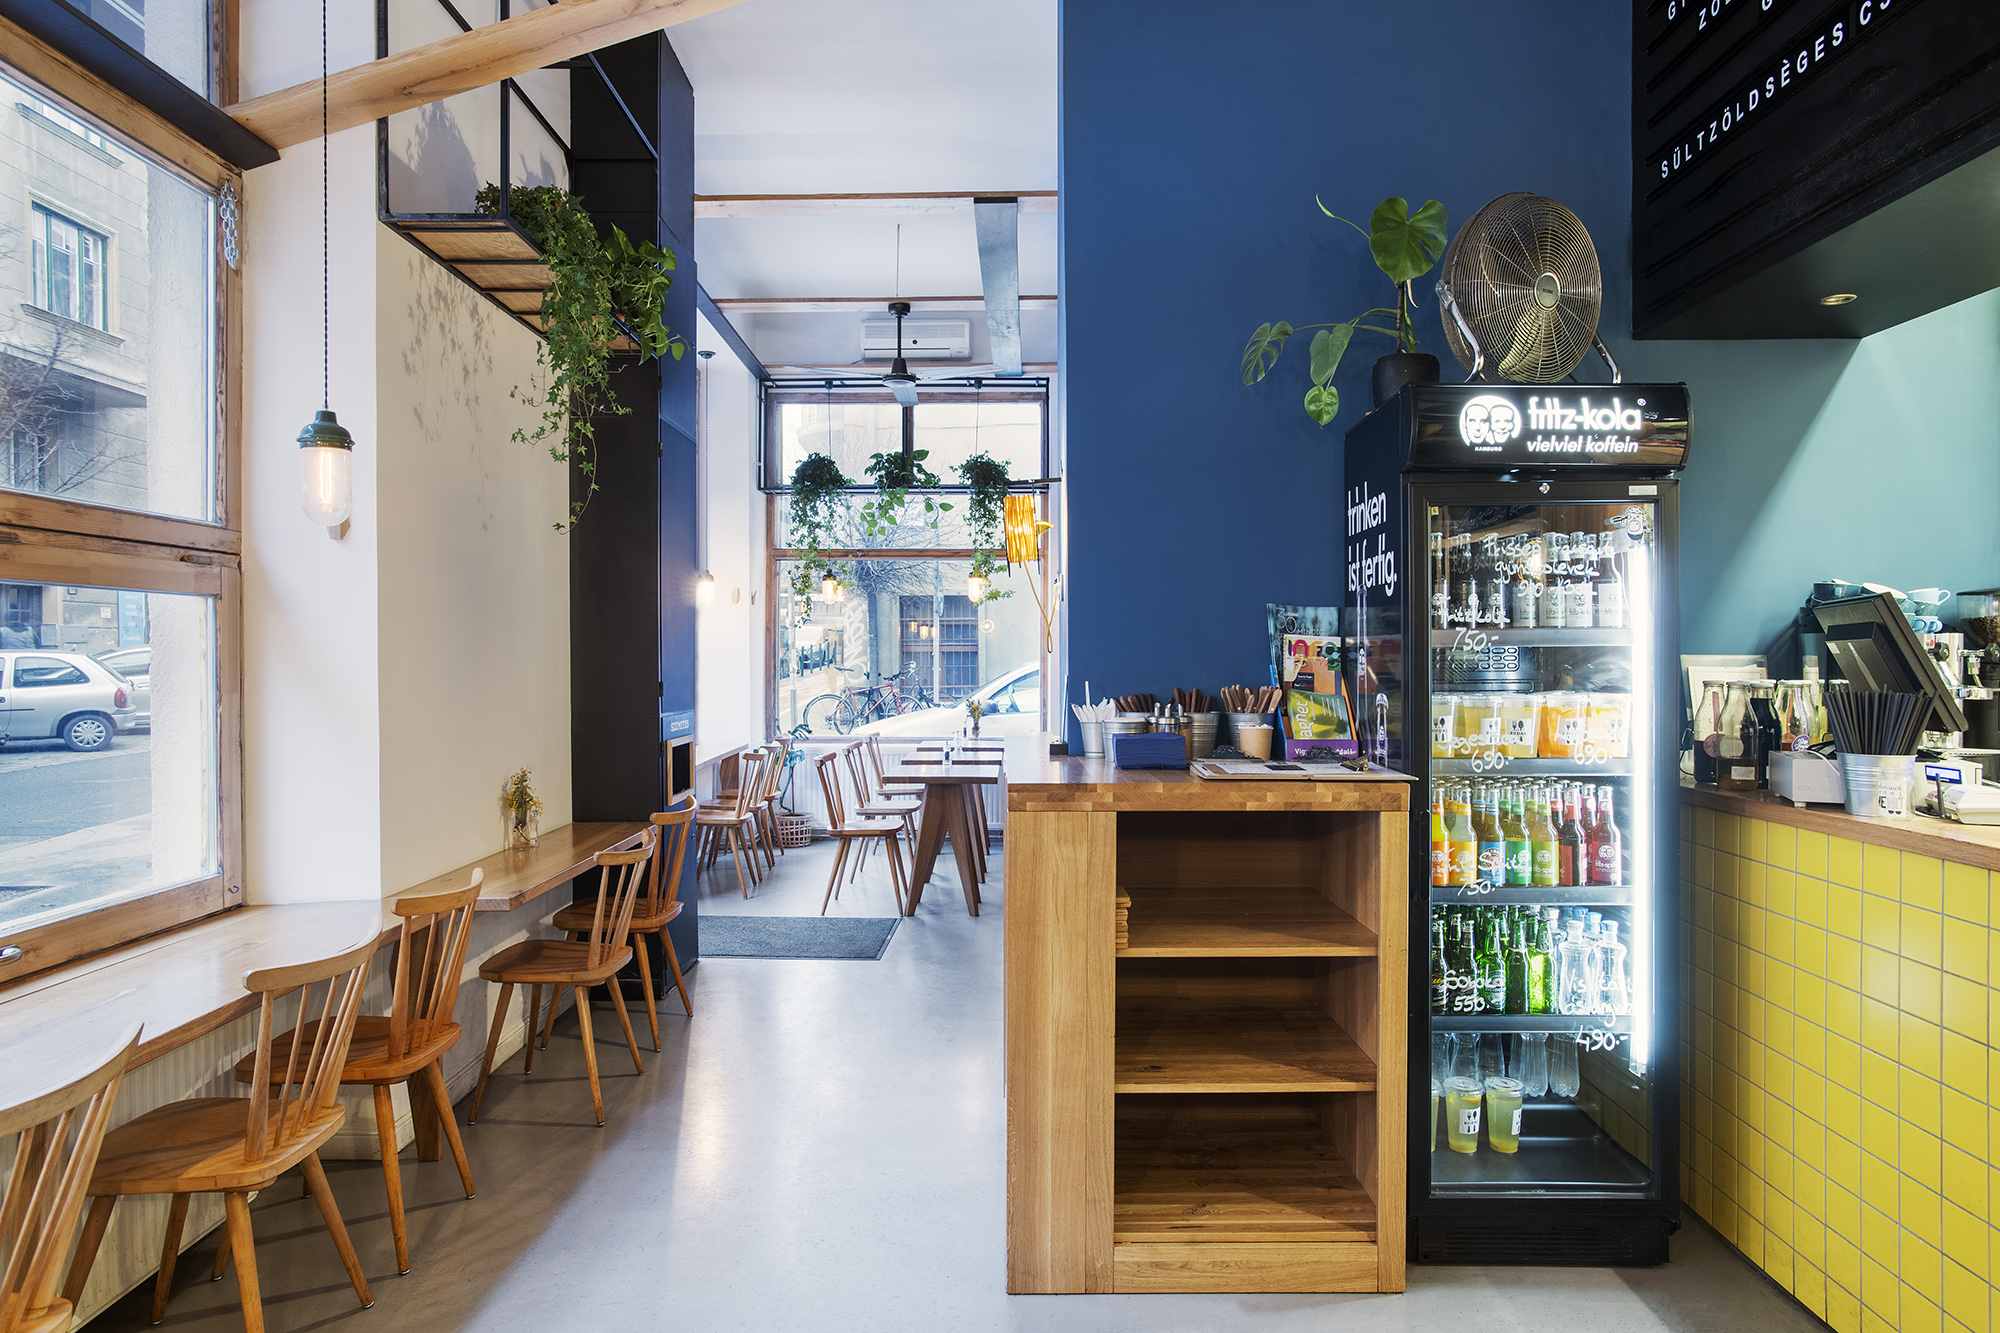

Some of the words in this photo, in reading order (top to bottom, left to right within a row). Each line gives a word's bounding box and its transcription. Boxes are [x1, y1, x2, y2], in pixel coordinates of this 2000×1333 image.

[1526, 434, 1584, 453] vielviel
[1585, 434, 1639, 453] koffein
[1347, 480, 1388, 537] trinken
[1348, 542, 1361, 592] ist
[1361, 532, 1398, 597] fertig.
